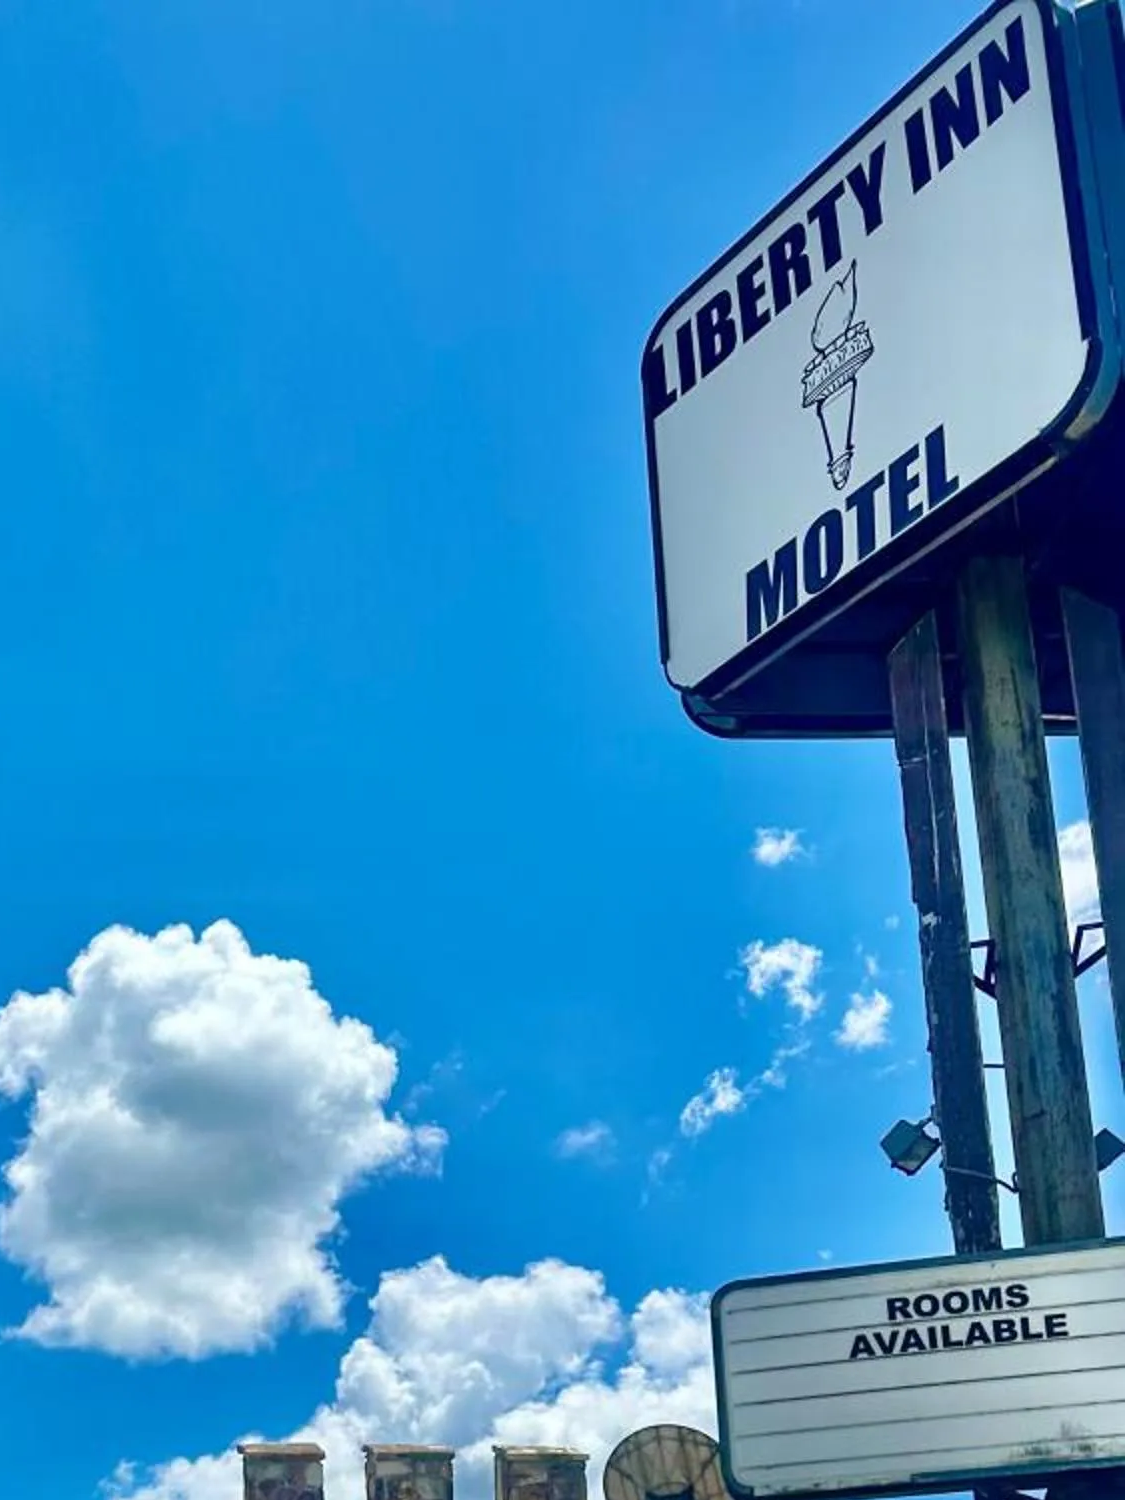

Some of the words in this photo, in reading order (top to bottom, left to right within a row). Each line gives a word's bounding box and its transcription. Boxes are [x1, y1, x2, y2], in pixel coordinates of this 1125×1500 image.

[649, 141, 886, 418] LIBERTY
[904, 15, 1030, 195] INN
[746, 424, 959, 642] MOTEL
[849, 1313, 1069, 1358] AVAILABLE
[886, 1284, 1029, 1321] ROOMS
